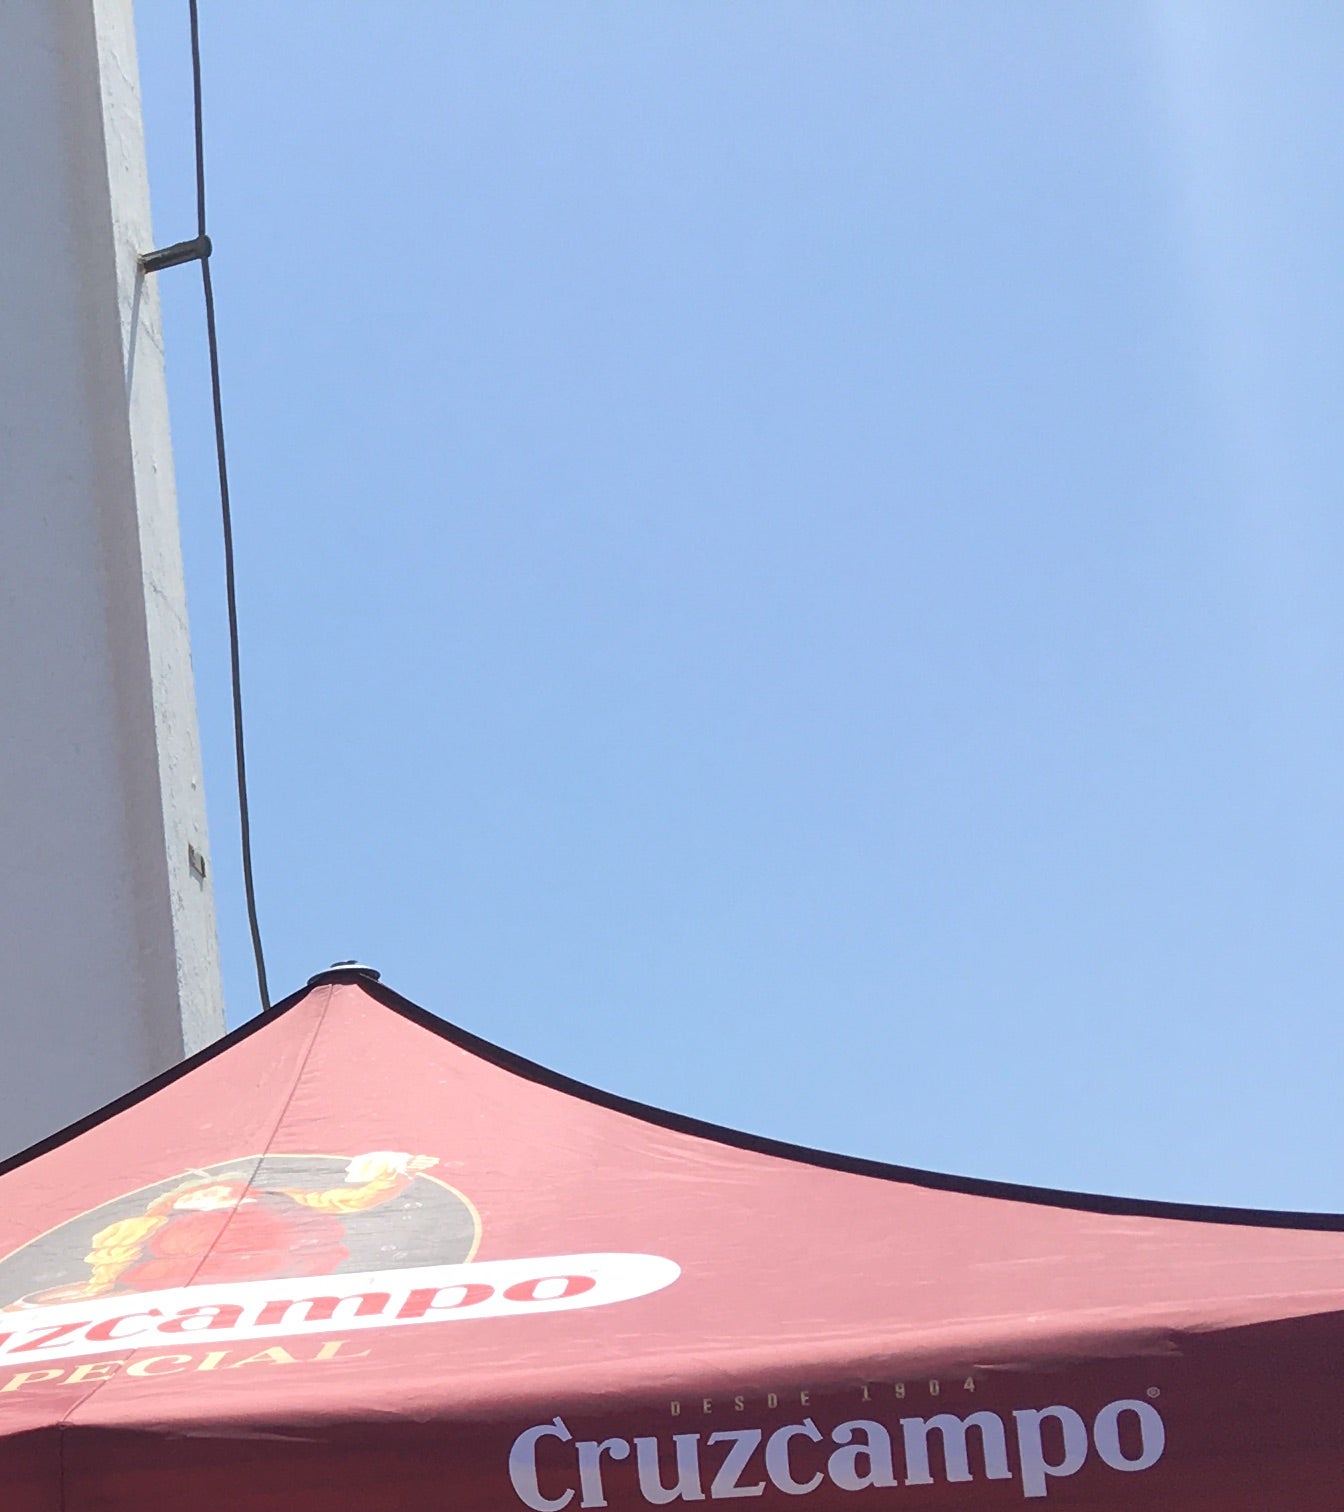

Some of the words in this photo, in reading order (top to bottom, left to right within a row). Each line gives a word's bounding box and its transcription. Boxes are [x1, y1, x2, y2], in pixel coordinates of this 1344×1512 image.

[670, 1391, 811, 1417] DESDE
[861, 1376, 976, 1402] 1904
[509, 1398, 1167, 1512] Cruzcampo
